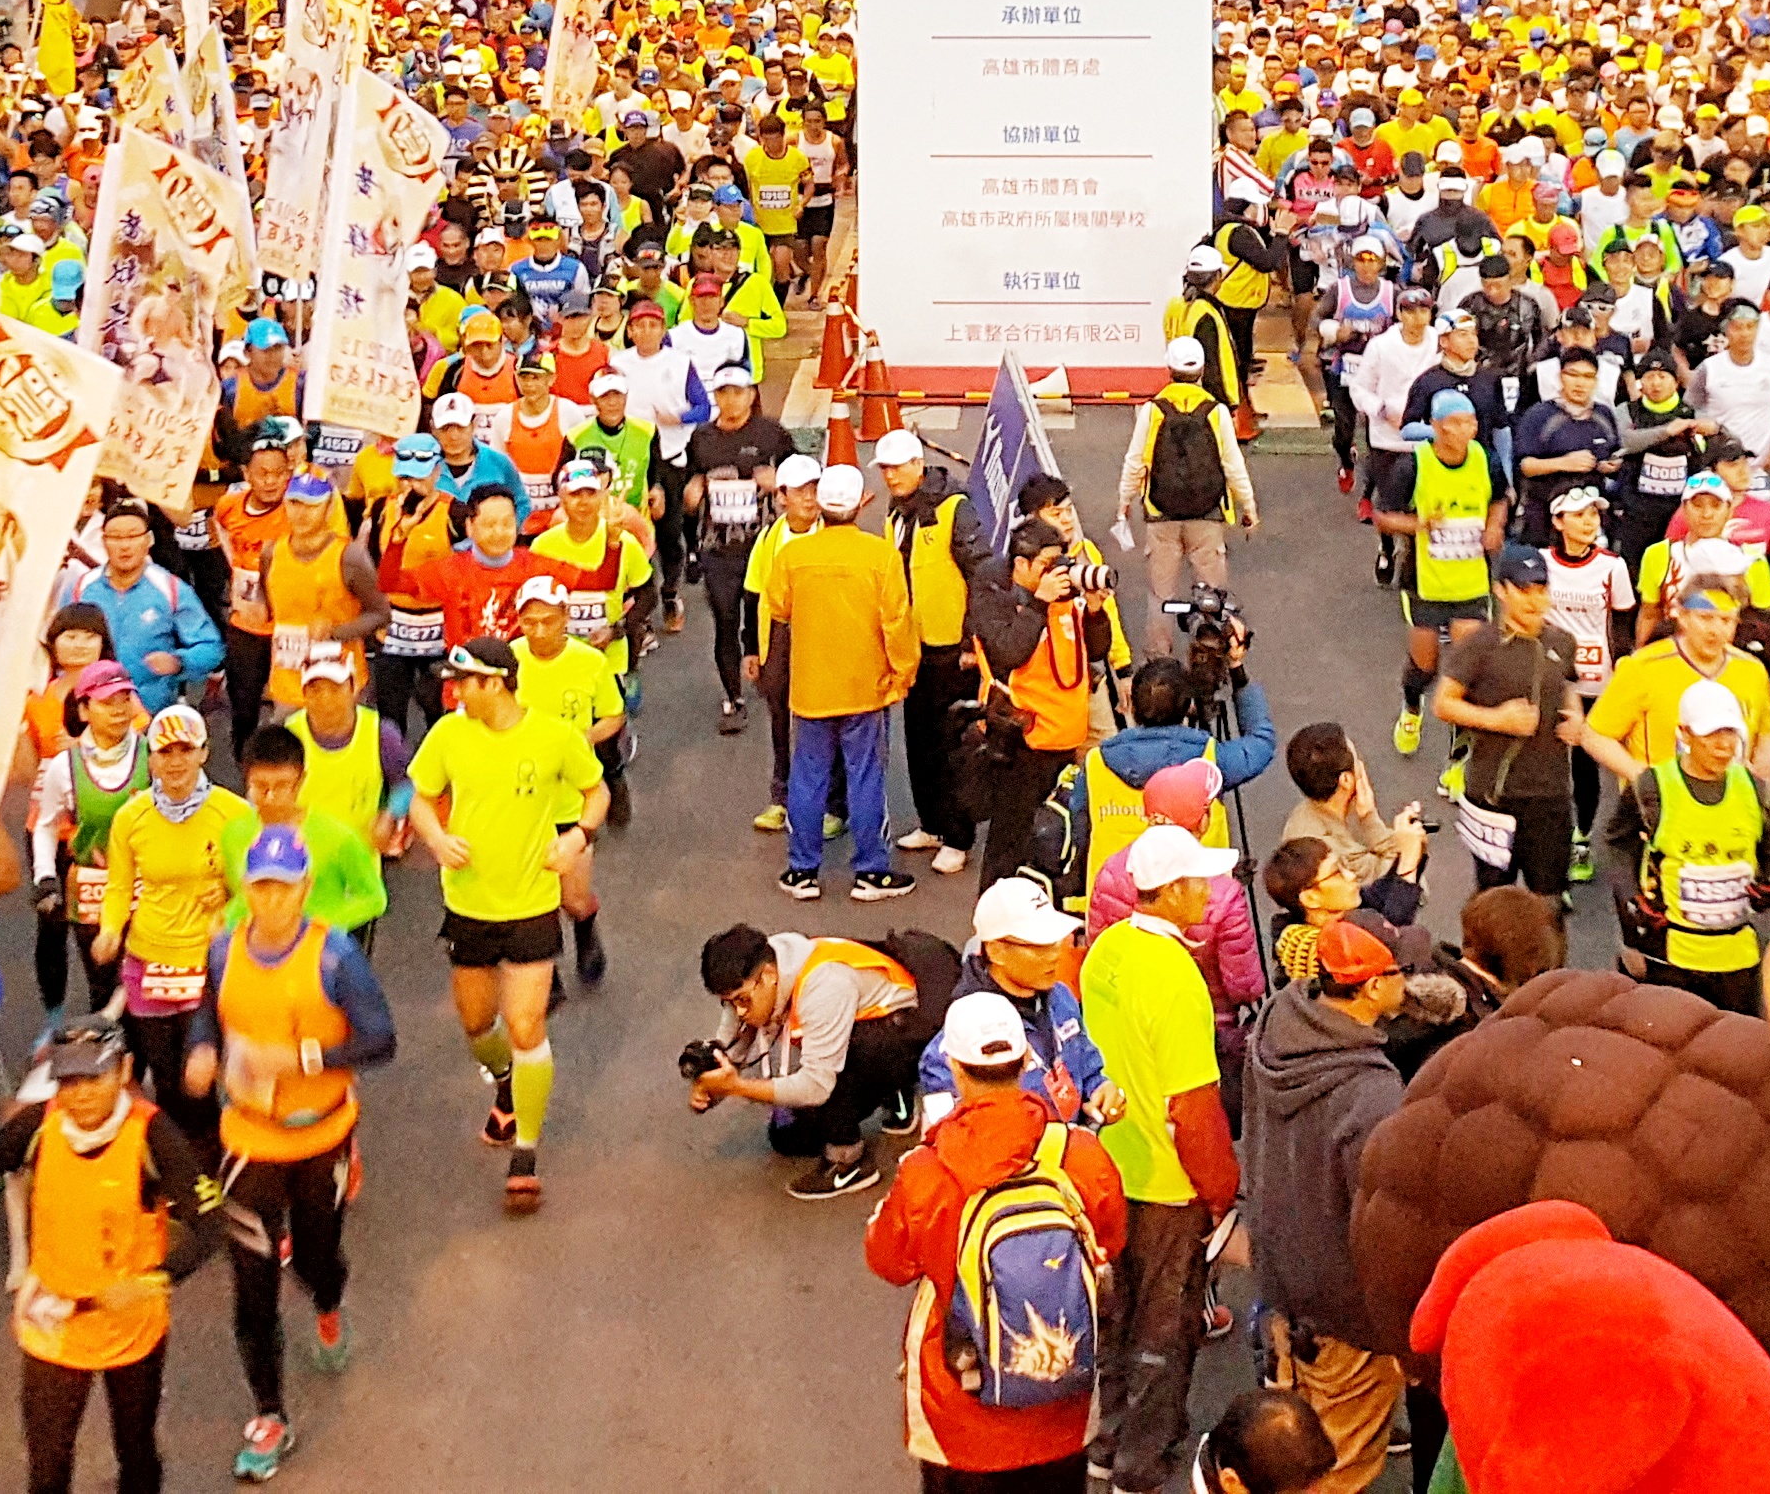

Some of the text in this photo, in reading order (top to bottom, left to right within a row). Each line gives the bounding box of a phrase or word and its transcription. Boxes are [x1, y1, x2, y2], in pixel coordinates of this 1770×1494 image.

[1000, 5, 1082, 25] 承辦單位
[982, 57, 1101, 77] 高雄市體育處
[1002, 124, 1082, 144] 協辦單位
[981, 177, 1100, 197] 高雄市體育會
[1003, 270, 1082, 290] 執行單位
[390, 623, 443, 640] 10277
